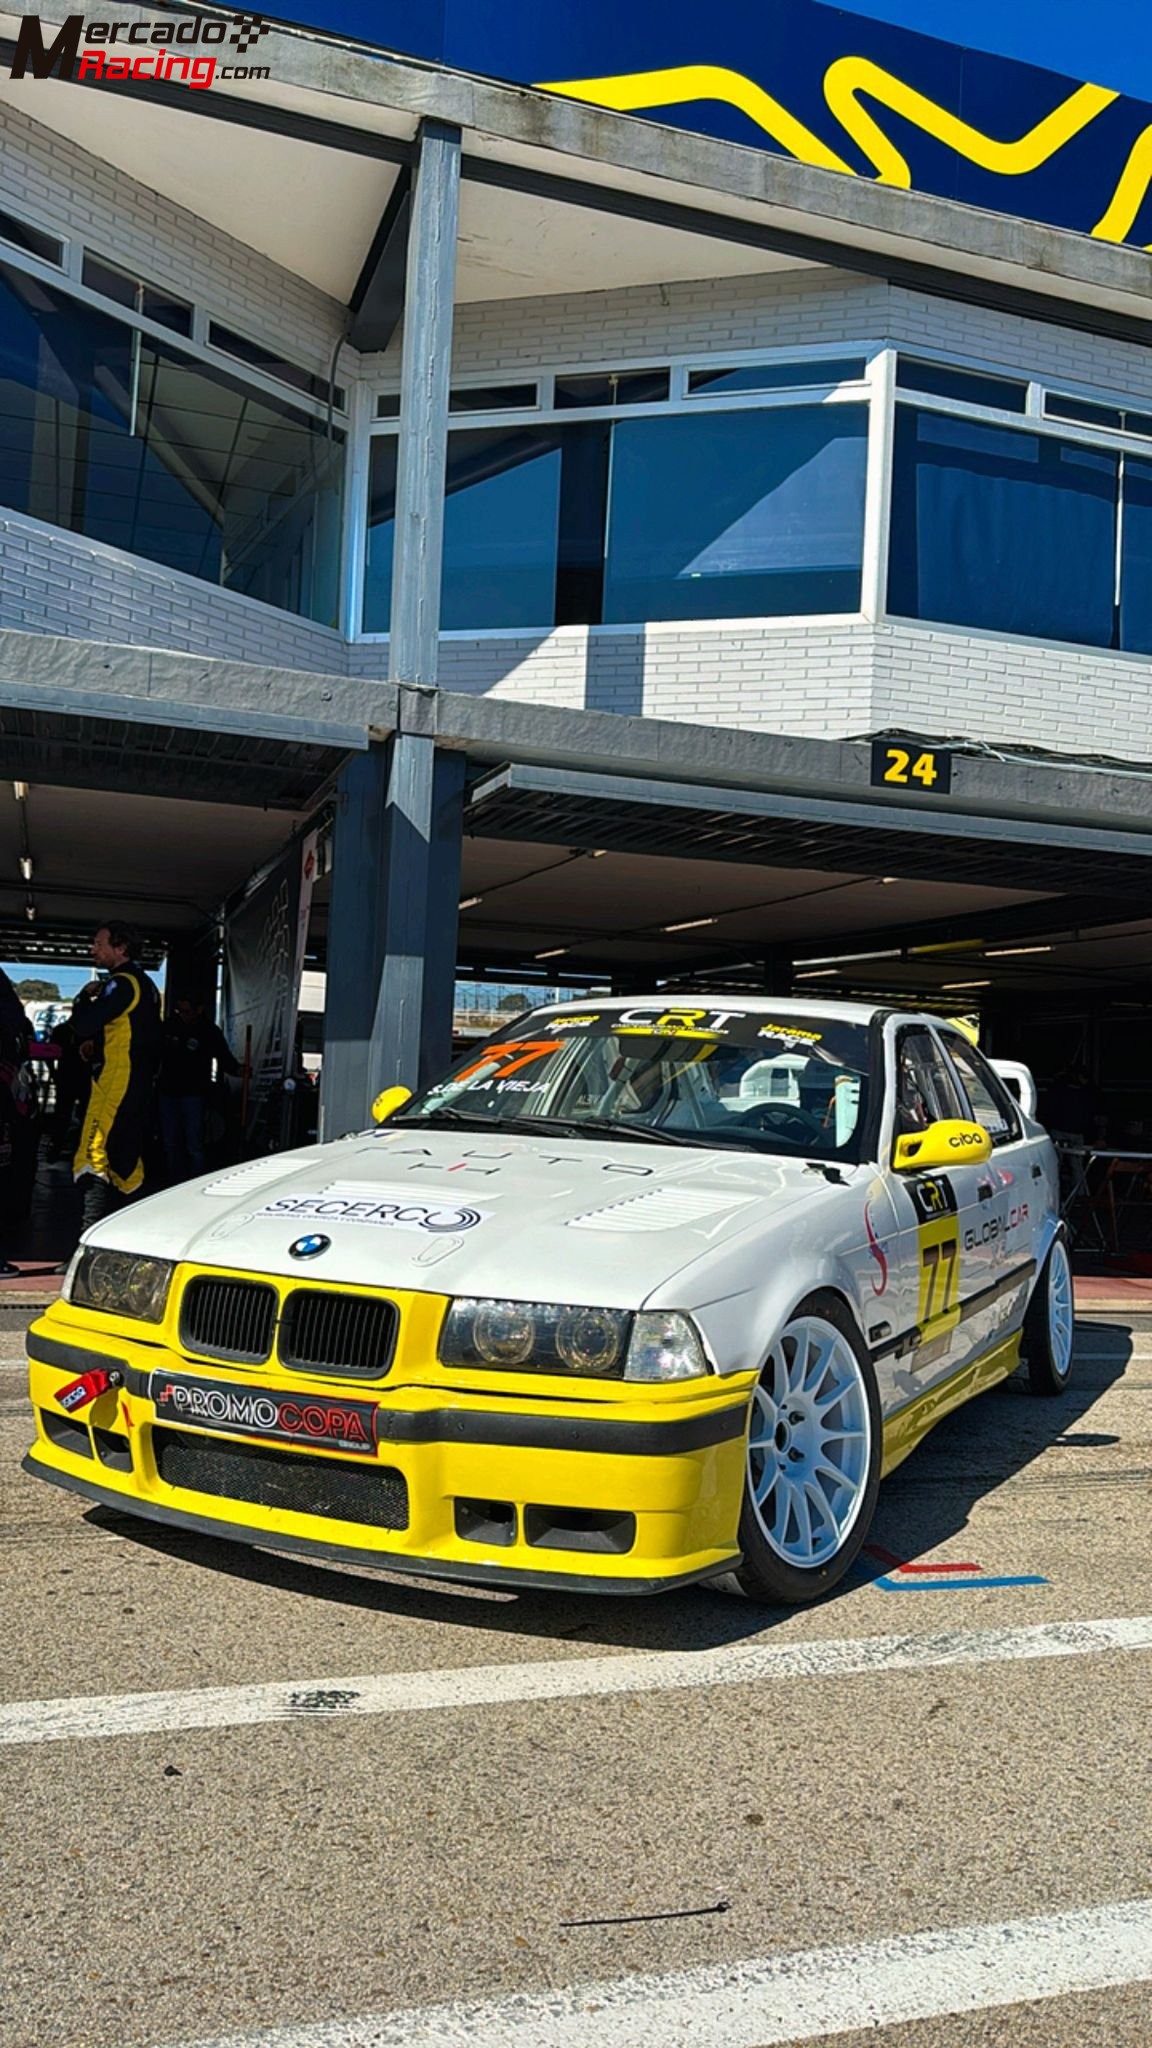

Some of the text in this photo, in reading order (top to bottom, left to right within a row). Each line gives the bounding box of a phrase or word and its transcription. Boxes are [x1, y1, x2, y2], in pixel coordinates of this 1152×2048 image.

[884, 749, 937, 786] 24
[618, 1008, 746, 1029] CRT
[453, 1040, 567, 1082] 77
[496, 1081, 551, 1094] VIEJA
[916, 1180, 949, 1213] CRT
[922, 1239, 958, 1323] 77
[172, 1384, 369, 1442] PROMOCOPA
